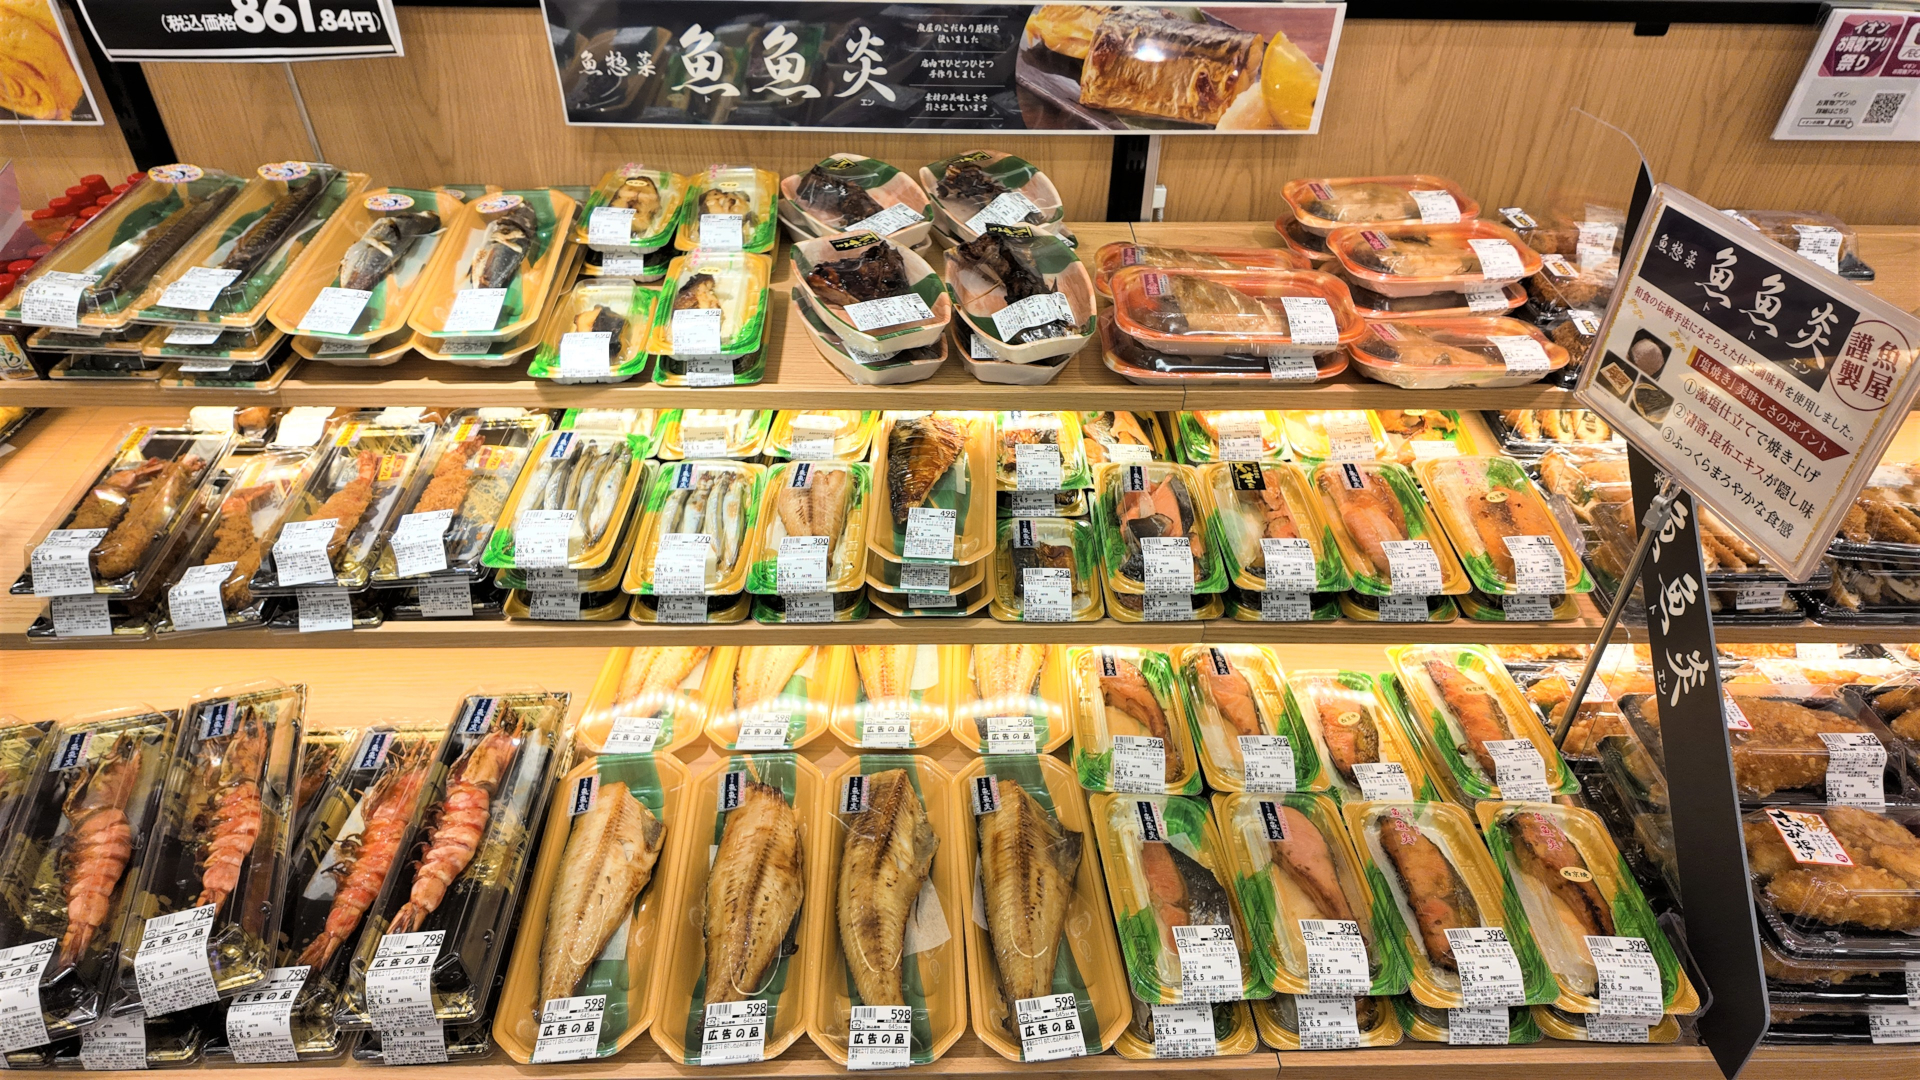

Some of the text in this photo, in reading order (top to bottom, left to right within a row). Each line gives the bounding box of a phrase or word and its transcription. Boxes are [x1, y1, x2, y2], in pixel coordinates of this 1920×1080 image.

[1854, 20, 1891, 35] イオン
[938, 34, 979, 44] 使いました
[1835, 36, 1892, 53] お買物アプリ
[578, 50, 657, 77] 魚惣菜
[671, 23, 896, 102] 魚魚炎
[1835, 54, 1870, 72] 祭り
[929, 69, 986, 79] 手作りしました
[861, 98, 875, 106] エン
[925, 92, 988, 102] 素材の美味しさを
[925, 103, 988, 112] 引き出しています
[1655, 233, 1696, 270] 魚惣菜
[1695, 247, 1840, 368] 魚魚炎
[1791, 357, 1811, 375] エン
[437, 511, 453, 519] 390
[940, 510, 956, 518] 498
[321, 520, 337, 528] 390
[813, 537, 829, 545] 300
[1293, 540, 1309, 548] 415
[1054, 569, 1070, 577] 258
[774, 713, 790, 721] 598
[895, 711, 910, 719] 598
[646, 720, 661, 729] 598
[1017, 719, 1033, 727] 598
[991, 733, 1031, 741] 広告の品
[1271, 737, 1288, 746] 398
[1856, 735, 1878, 744] 398
[1147, 738, 1163, 747] 398
[1514, 741, 1534, 749] 398
[1114, 769, 1133, 777] 26.6.5
[1385, 764, 1404, 773] 398
[192, 906, 215, 919] 798
[1213, 928, 1232, 938] 398
[1337, 923, 1358, 933] 398
[145, 927, 204, 949] 広告の品
[423, 933, 443, 944] 798
[1484, 930, 1505, 939] 398
[32, 942, 55, 953] 798
[1626, 939, 1648, 949] 398
[374, 956, 430, 968] 広告の品
[288, 969, 309, 981] 798
[1309, 966, 1331, 974] 26.6.5
[138, 973, 164, 983] 26.6.5
[1461, 974, 1484, 982] 26.6.5
[1600, 982, 1623, 990] 26.6.5
[237, 989, 292, 1003] 広告の品
[584, 998, 604, 1010] 598
[1054, 996, 1075, 1007] 598
[746, 1002, 767, 1014] 598
[891, 1009, 911, 1020] 598
[1025, 1019, 1076, 1037] 広告の品
[1299, 1019, 1321, 1027] 26.6.5
[542, 1021, 595, 1038] 広告の品
[707, 1025, 759, 1040] 広告の品
[1154, 1027, 1177, 1035] 26.6.5
[853, 1032, 905, 1045] 広告の品
